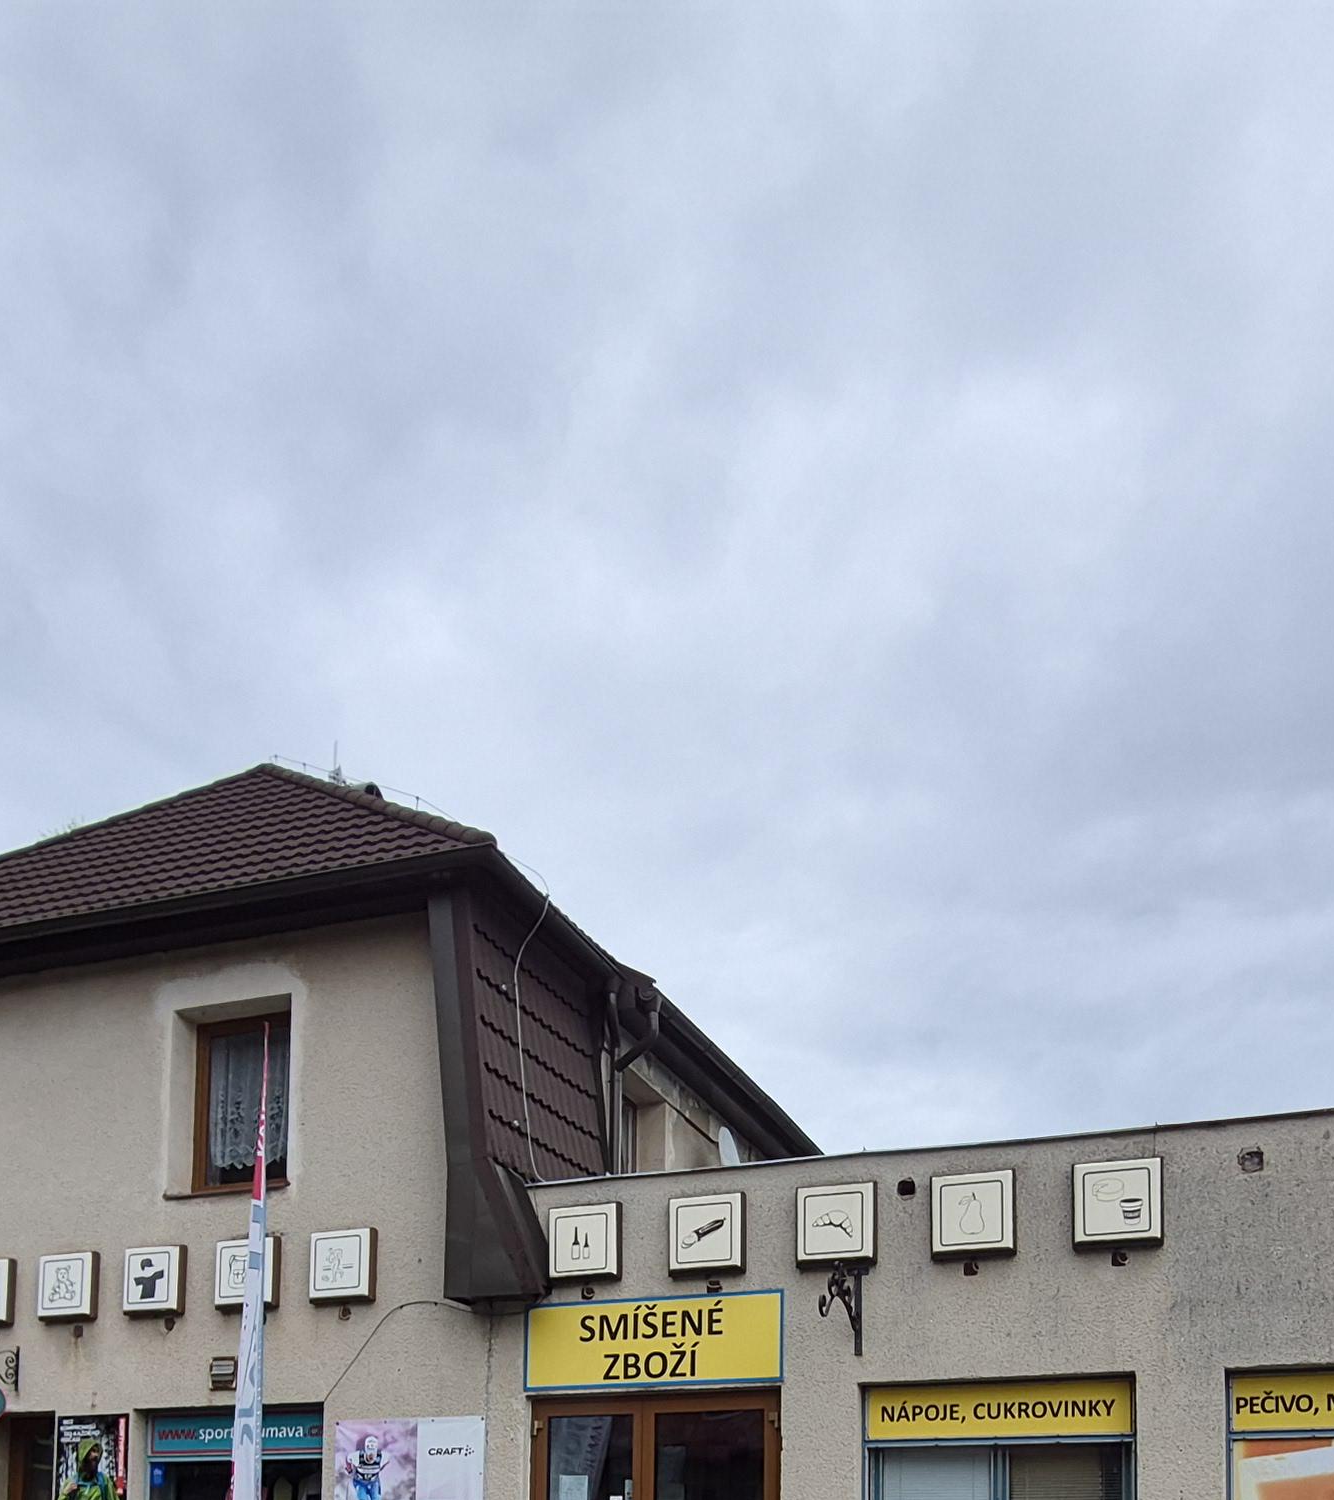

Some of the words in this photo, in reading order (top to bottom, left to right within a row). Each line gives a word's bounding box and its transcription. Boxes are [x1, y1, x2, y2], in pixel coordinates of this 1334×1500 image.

[579, 1300, 723, 1343] SMÍŠENÉ
[602, 1341, 700, 1380] ZBOŽÍ
[880, 1400, 967, 1424] NÁPOJE,
[973, 1398, 1117, 1420] CUKROVINKY
[1235, 1390, 1320, 1416] PEČIVO,
[428, 1447, 464, 1456] CRAFT
